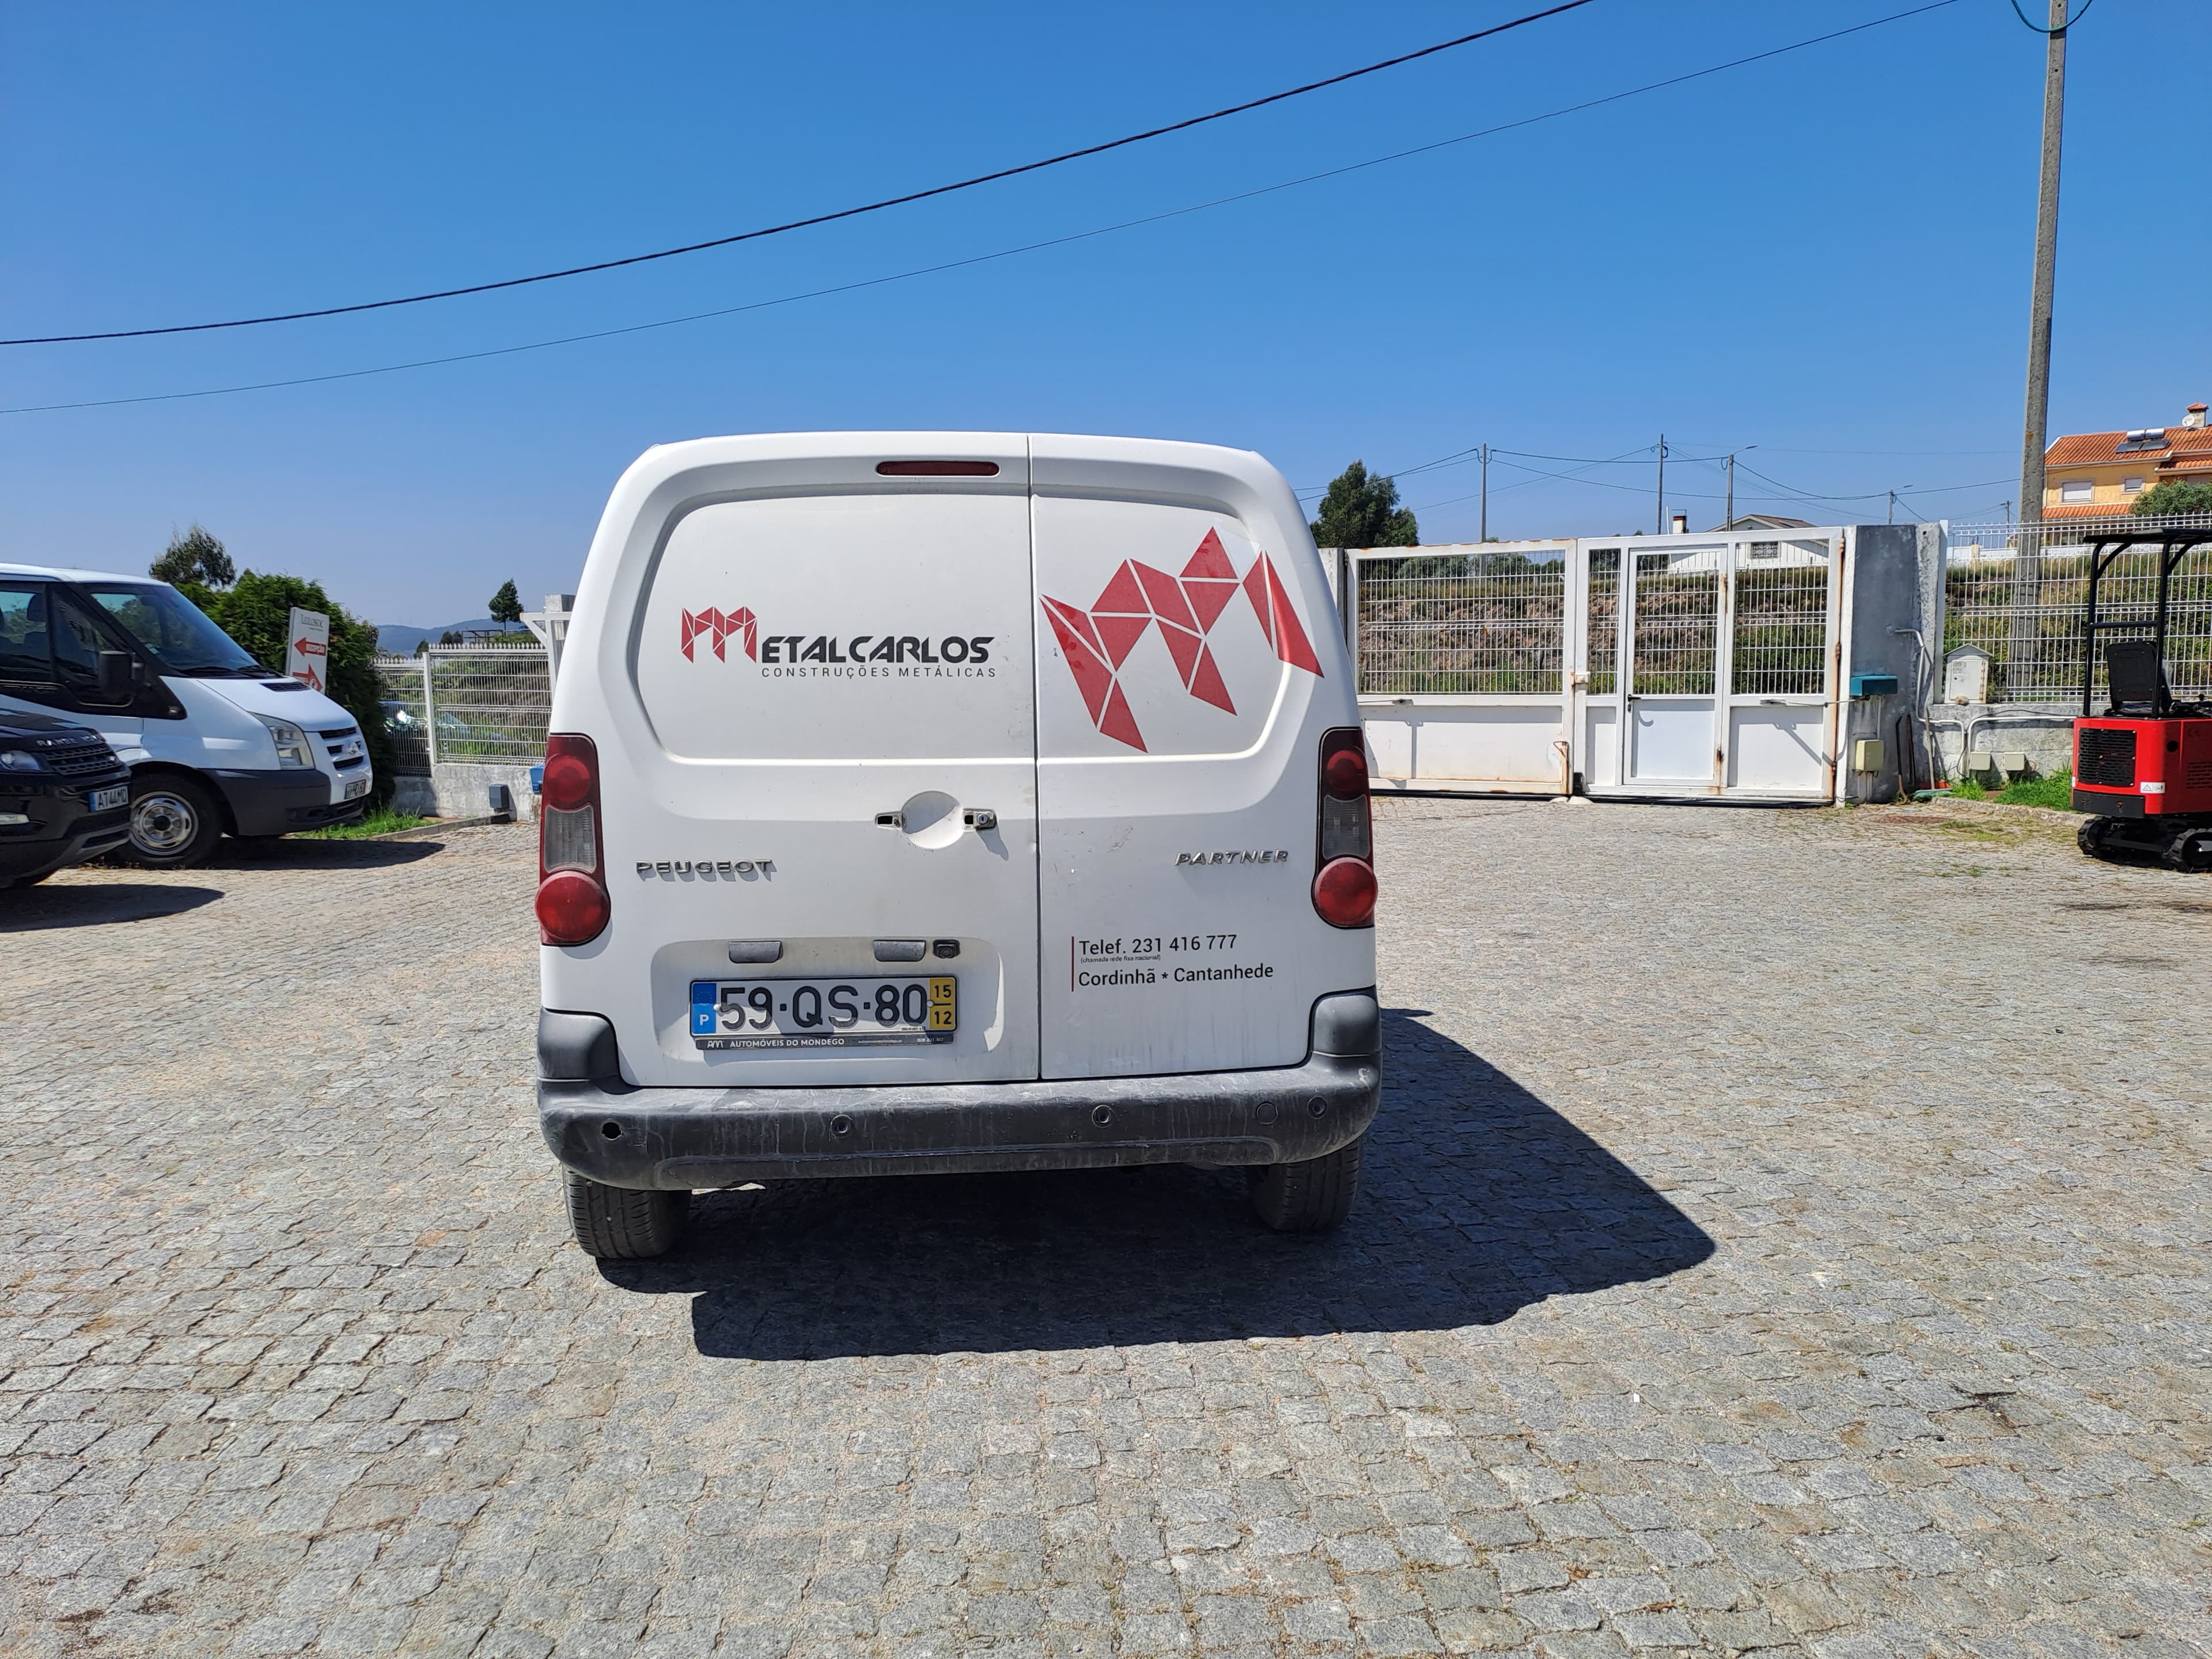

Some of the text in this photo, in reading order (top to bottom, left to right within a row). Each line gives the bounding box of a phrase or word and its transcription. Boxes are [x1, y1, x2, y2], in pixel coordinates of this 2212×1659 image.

[762, 665, 996, 680] CONSTRUÇÕES METÁLICAS
[1175, 849, 1288, 866] PARTNER
[636, 859, 772, 873] PEUGEOT
[1079, 934, 1237, 955] Telef. 231 416 777
[1078, 968, 1156, 986] Cordinhã
[1174, 963, 1274, 982] Cantanhede
[934, 985, 951, 998] 15
[699, 1014, 709, 1026] P
[934, 1011, 952, 1024] 12
[730, 1039, 784, 1048] AUTOMÓVEIS
